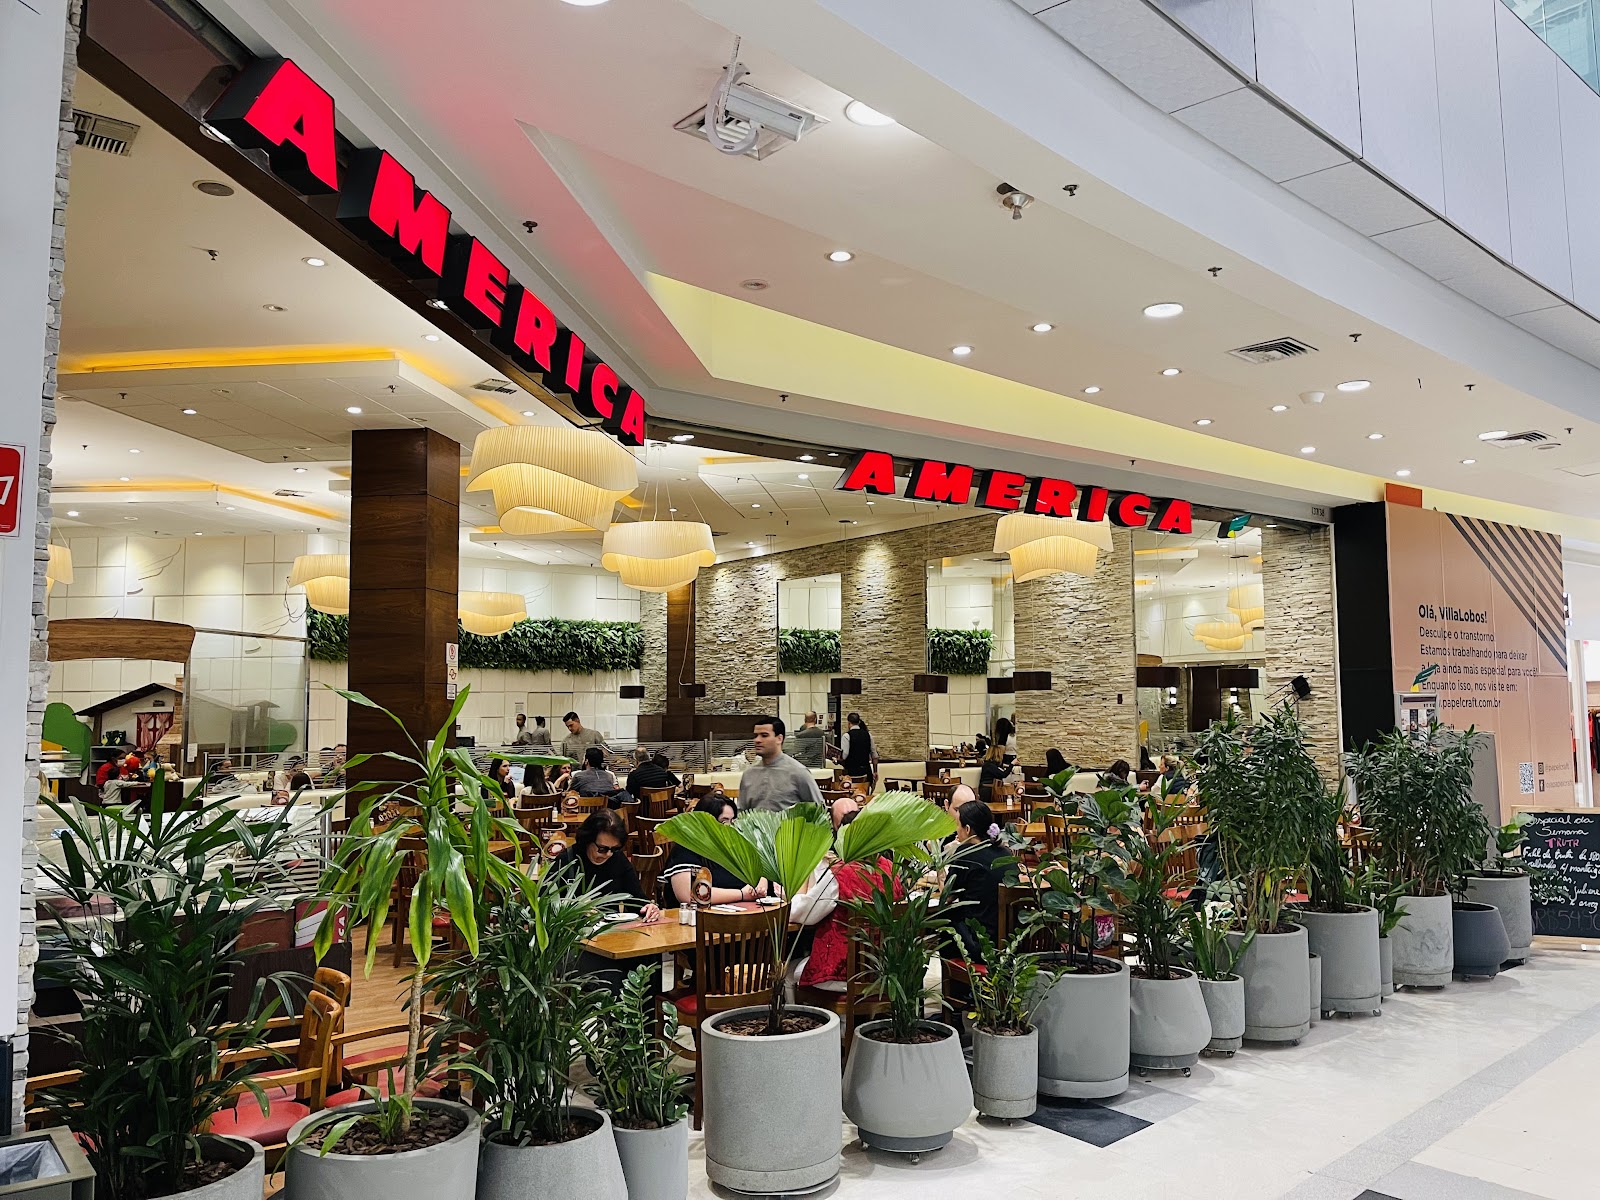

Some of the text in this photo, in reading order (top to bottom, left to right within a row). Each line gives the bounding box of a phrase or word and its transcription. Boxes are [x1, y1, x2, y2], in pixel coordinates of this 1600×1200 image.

[242, 57, 646, 446] AMERICA
[844, 450, 1193, 535] AMERICA
[1418, 604, 1488, 624] Olá, VillaLobos!
[1419, 626, 1452, 640] Desculpe
[1453, 631, 1459, 639] o
[1420, 644, 1528, 661] Estamos trabalhando para deixar
[1427, 662, 1440, 676] lja
[1442, 663, 1462, 674] ainda
[1463, 666, 1479, 675] mais
[1480, 666, 1507, 677] especial
[1507, 667, 1522, 678] para
[1422, 680, 1518, 692] Enquanto isso, nos viste em:
[1423, 697, 1501, 710] .papelcraft.com.br
[1535, 826, 1589, 837] Semana
